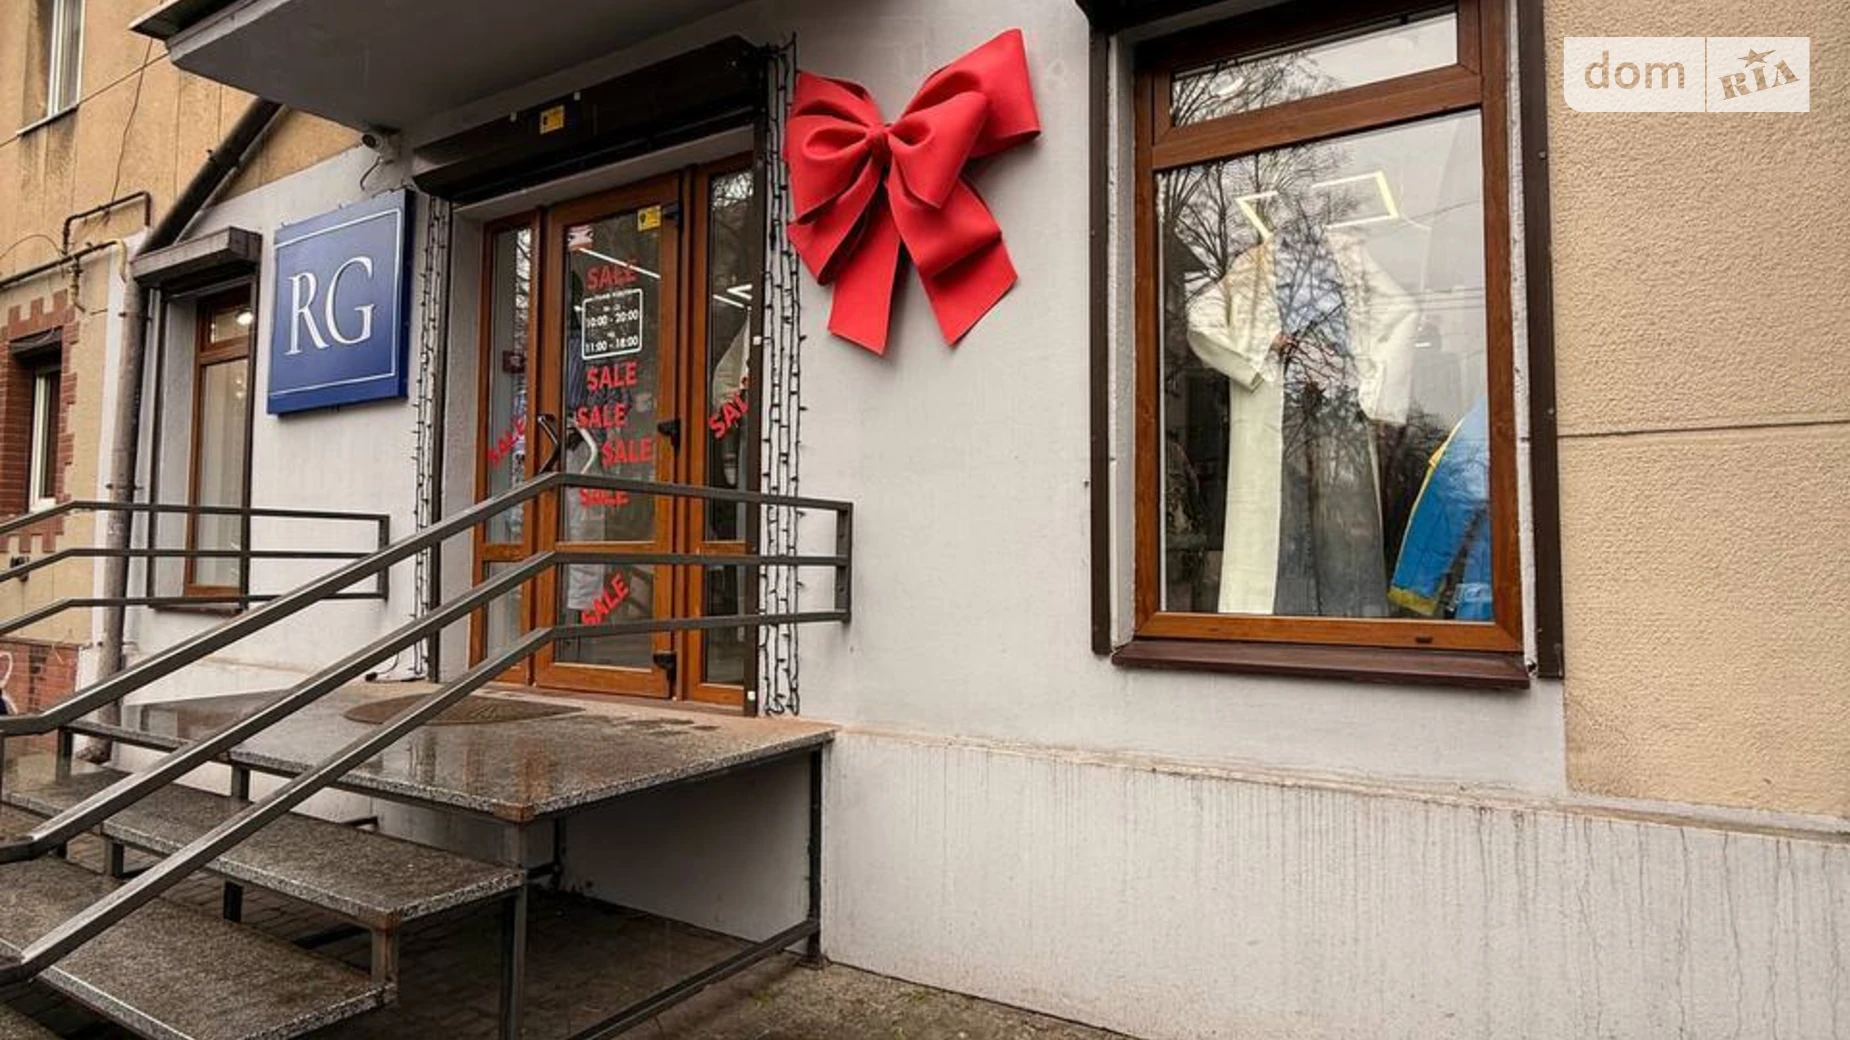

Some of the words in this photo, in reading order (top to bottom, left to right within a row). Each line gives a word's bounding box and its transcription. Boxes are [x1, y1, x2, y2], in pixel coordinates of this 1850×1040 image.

[587, 263, 638, 289] SALE
[284, 256, 375, 356] RG
[615, 309, 639, 323] 20:00
[587, 362, 638, 390] SALE
[577, 403, 627, 429] SALE
[708, 394, 749, 439] SAL
[602, 439, 652, 466] SALE
[581, 572, 629, 625] SALE
